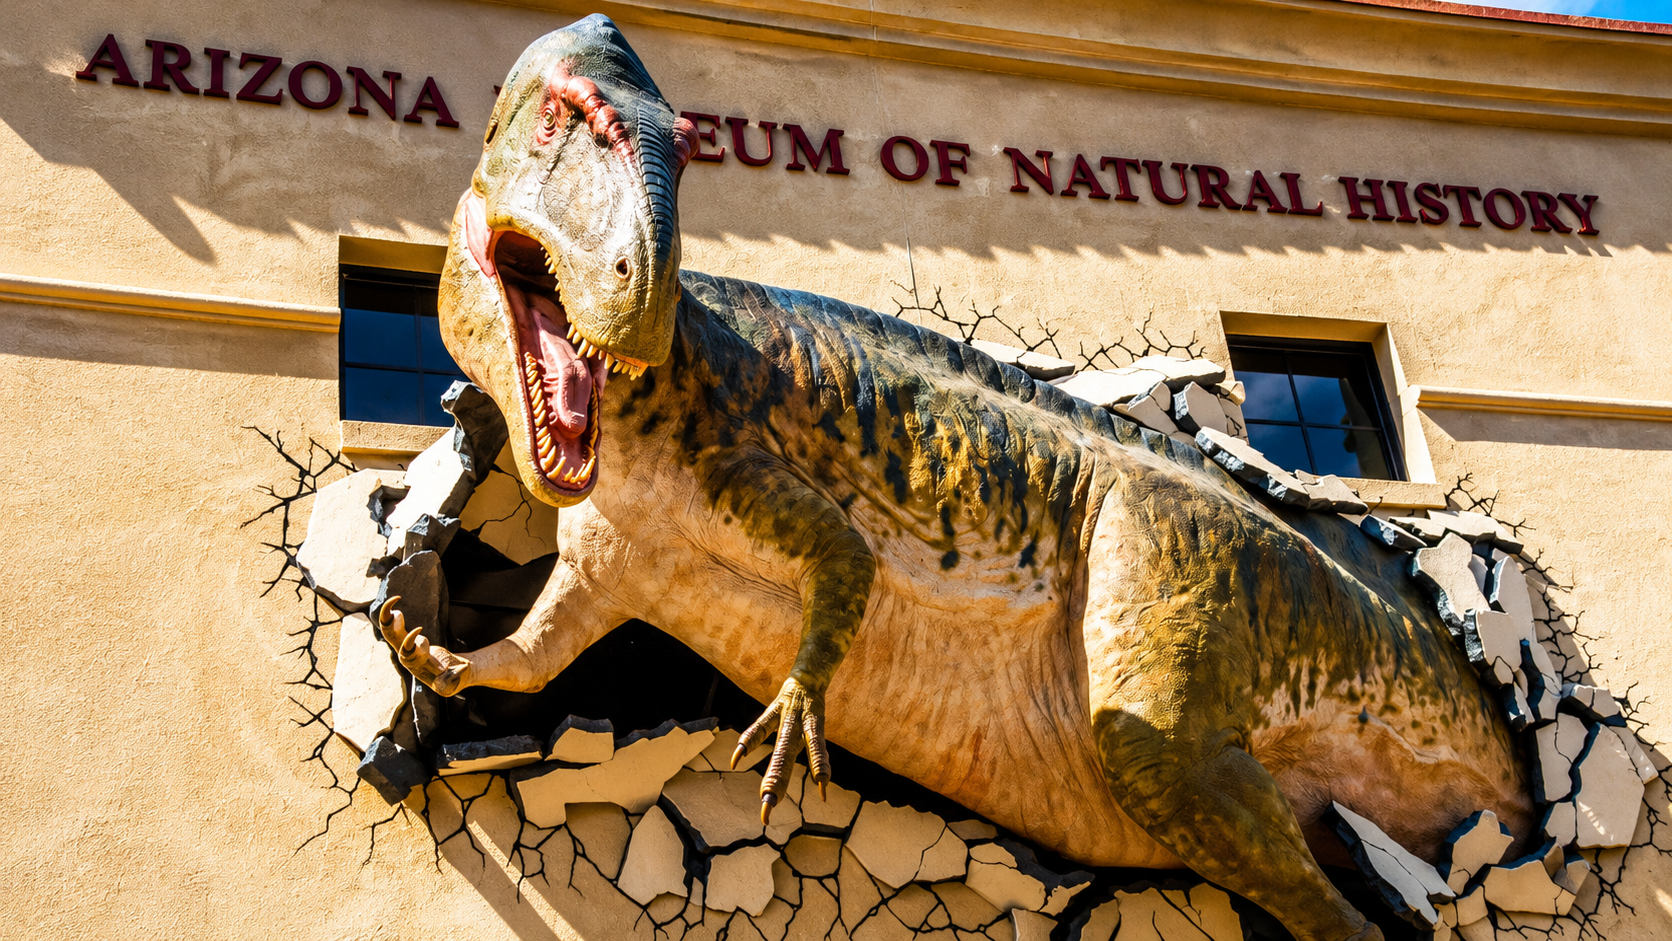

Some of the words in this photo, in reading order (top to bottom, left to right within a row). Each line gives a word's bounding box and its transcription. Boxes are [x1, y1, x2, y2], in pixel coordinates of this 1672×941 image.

[76, 33, 460, 128] ARIZONA
[880, 135, 971, 187] OF
[1003, 147, 1323, 217] NATURAL
[1338, 176, 1600, 236] HISTORY
